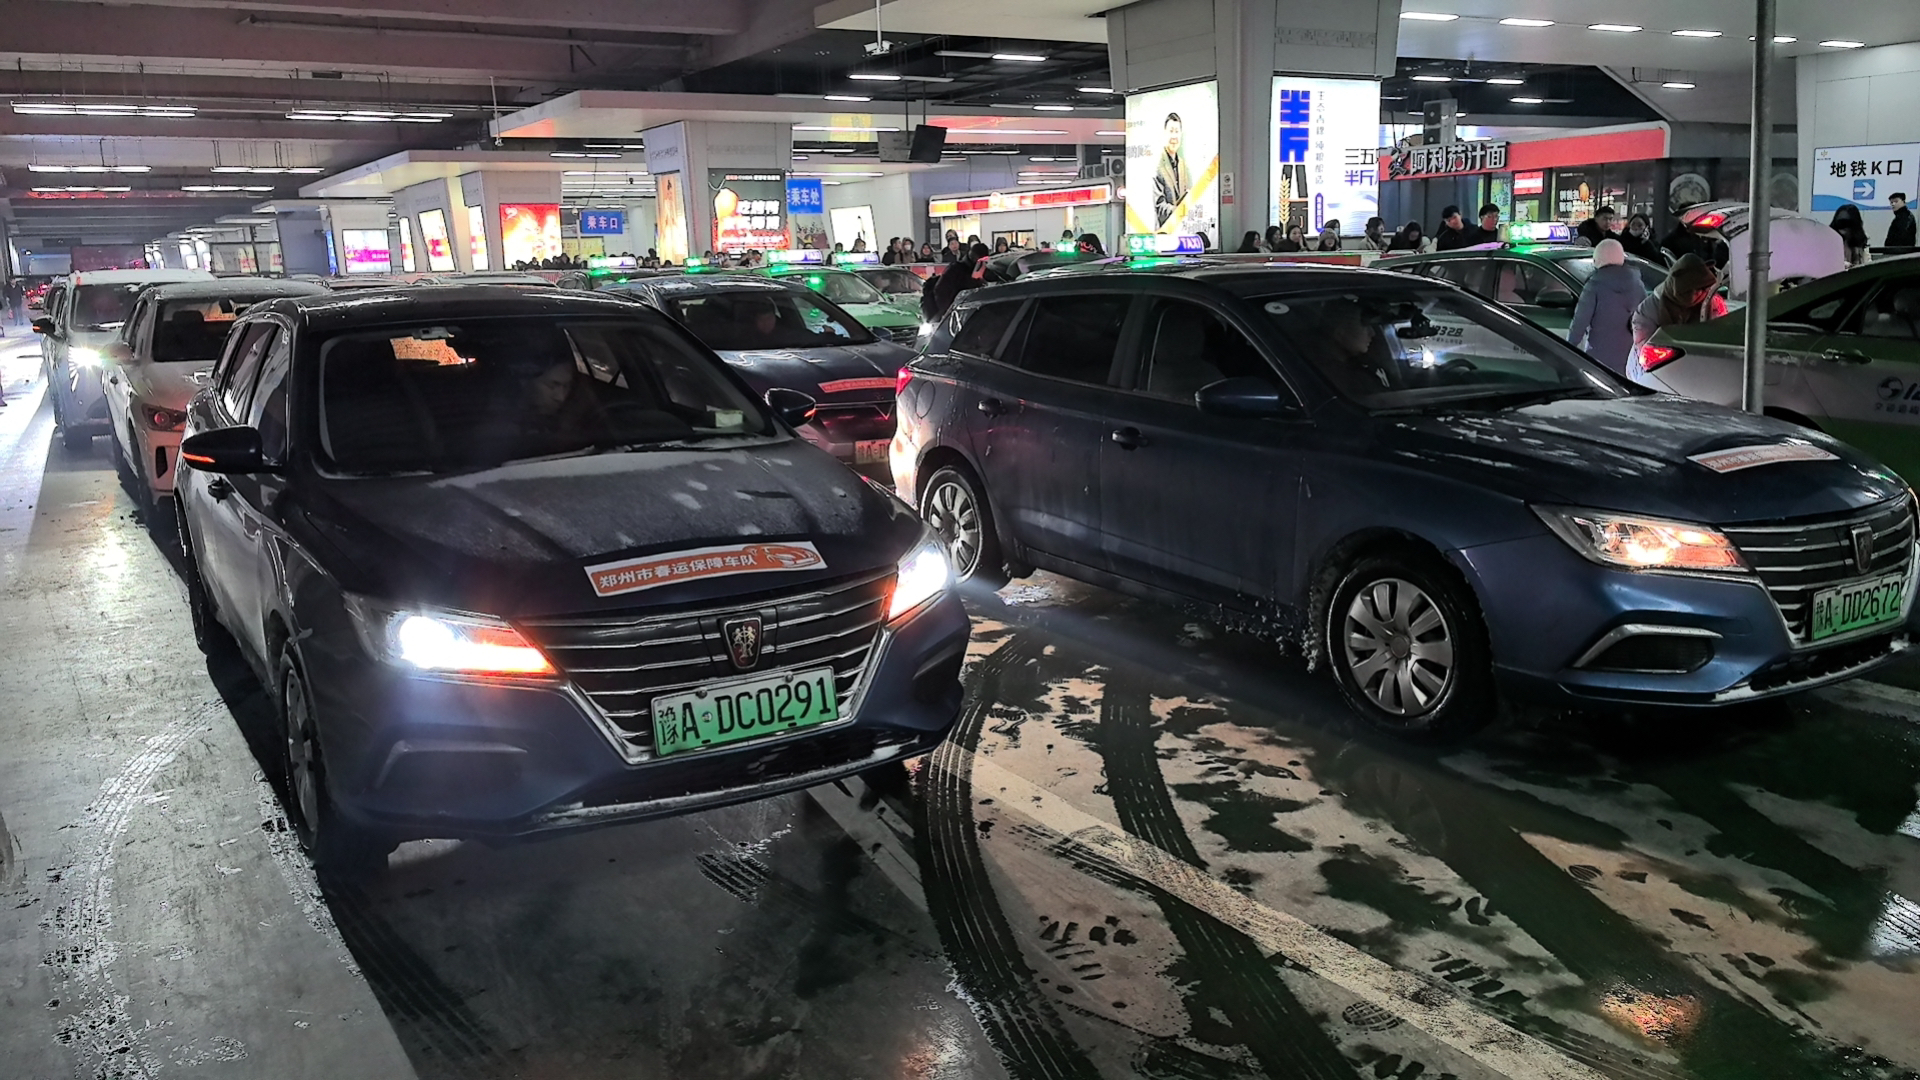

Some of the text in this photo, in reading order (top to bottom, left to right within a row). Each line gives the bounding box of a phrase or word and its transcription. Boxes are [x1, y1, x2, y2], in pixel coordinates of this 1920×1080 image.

[1345, 148, 1379, 165] 三五
[1410, 141, 1508, 175] 阿利茄汁面
[1830, 159, 1903, 178] 地铁K口
[1344, 169, 1379, 186] 半斤
[587, 215, 618, 230] 乘车口
[1181, 237, 1201, 249] TAXI
[599, 554, 758, 589] 郑州市春运保障车队
